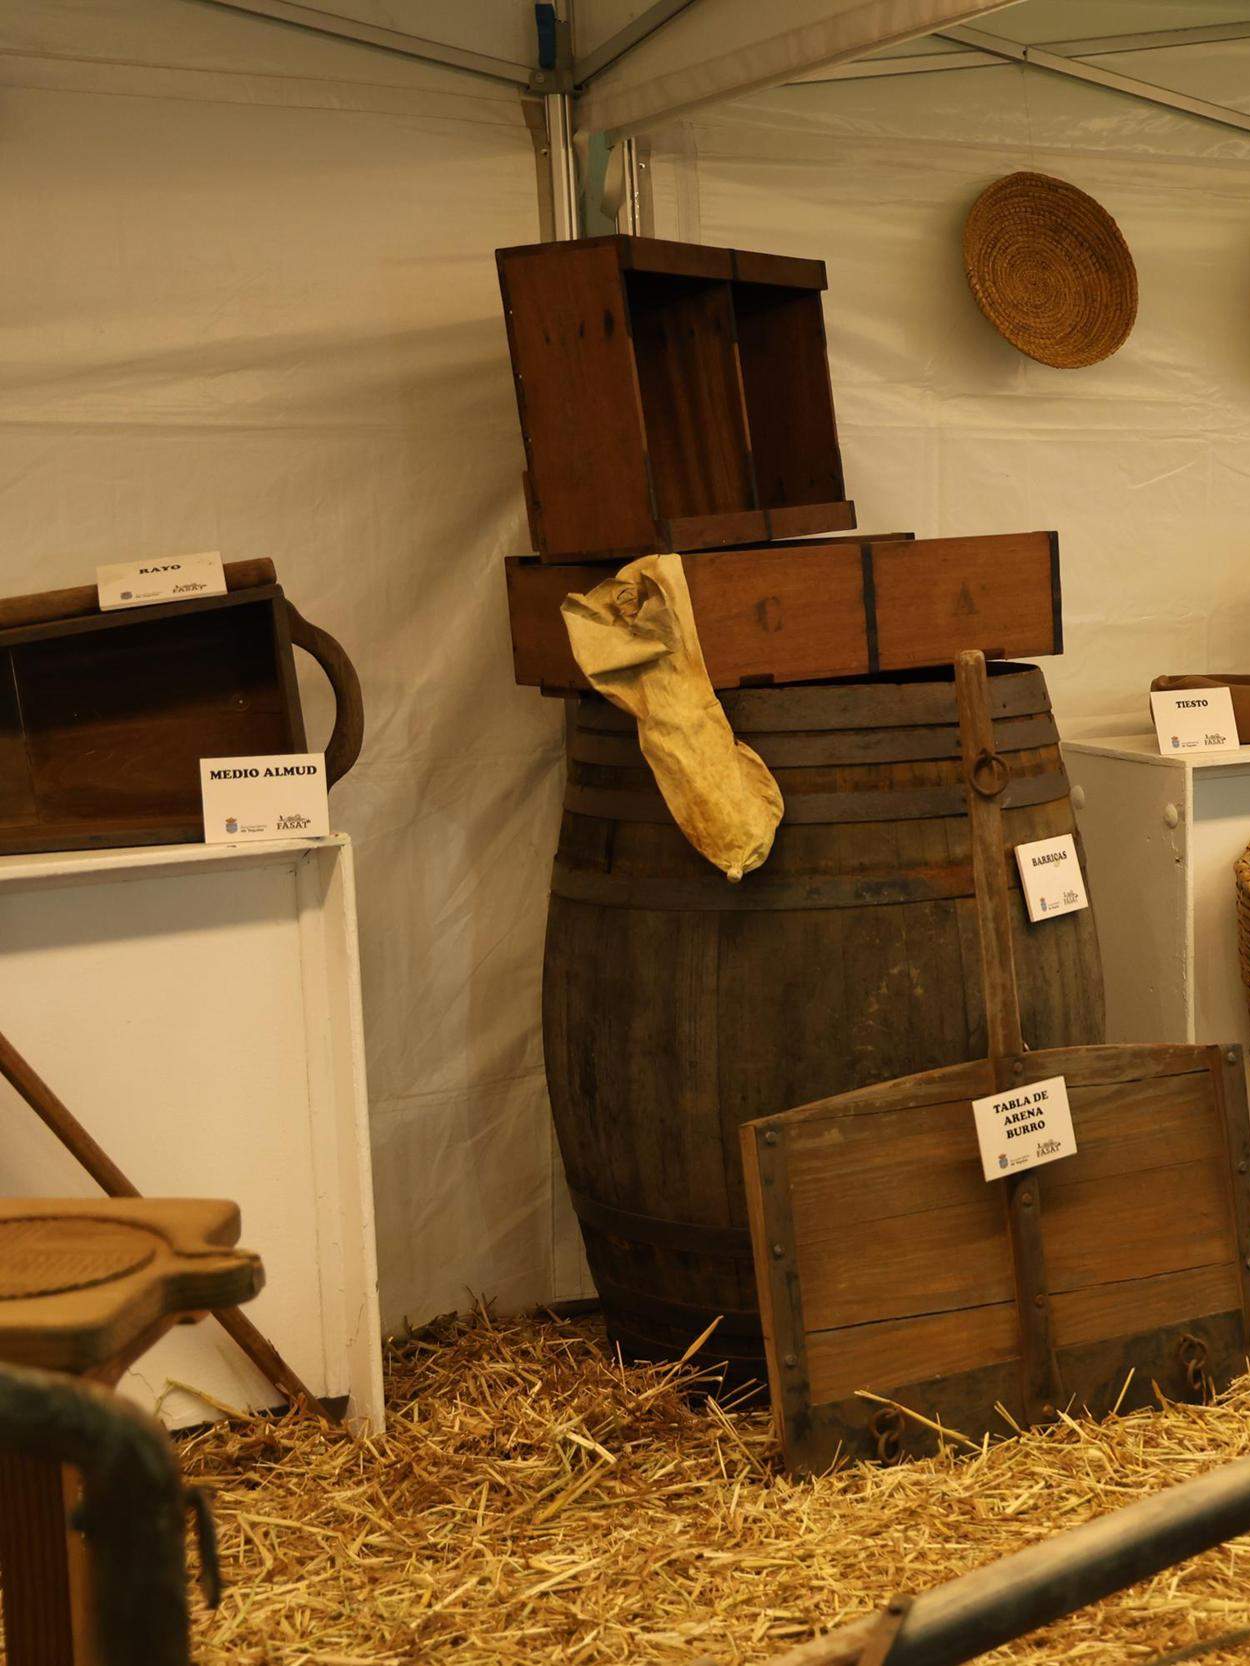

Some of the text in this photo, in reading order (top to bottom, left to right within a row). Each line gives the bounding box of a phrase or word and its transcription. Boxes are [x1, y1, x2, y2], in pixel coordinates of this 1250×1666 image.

[139, 564, 182, 575] RAYO
[1175, 699, 1209, 709] TIESTO
[209, 765, 318, 780] MEDIO ALMUD
[1031, 850, 1068, 867] BARRICAS
[993, 1090, 1049, 1114] TABLA DE
[1004, 1106, 1044, 1126] ARENA
[1006, 1120, 1046, 1140] BURRO
